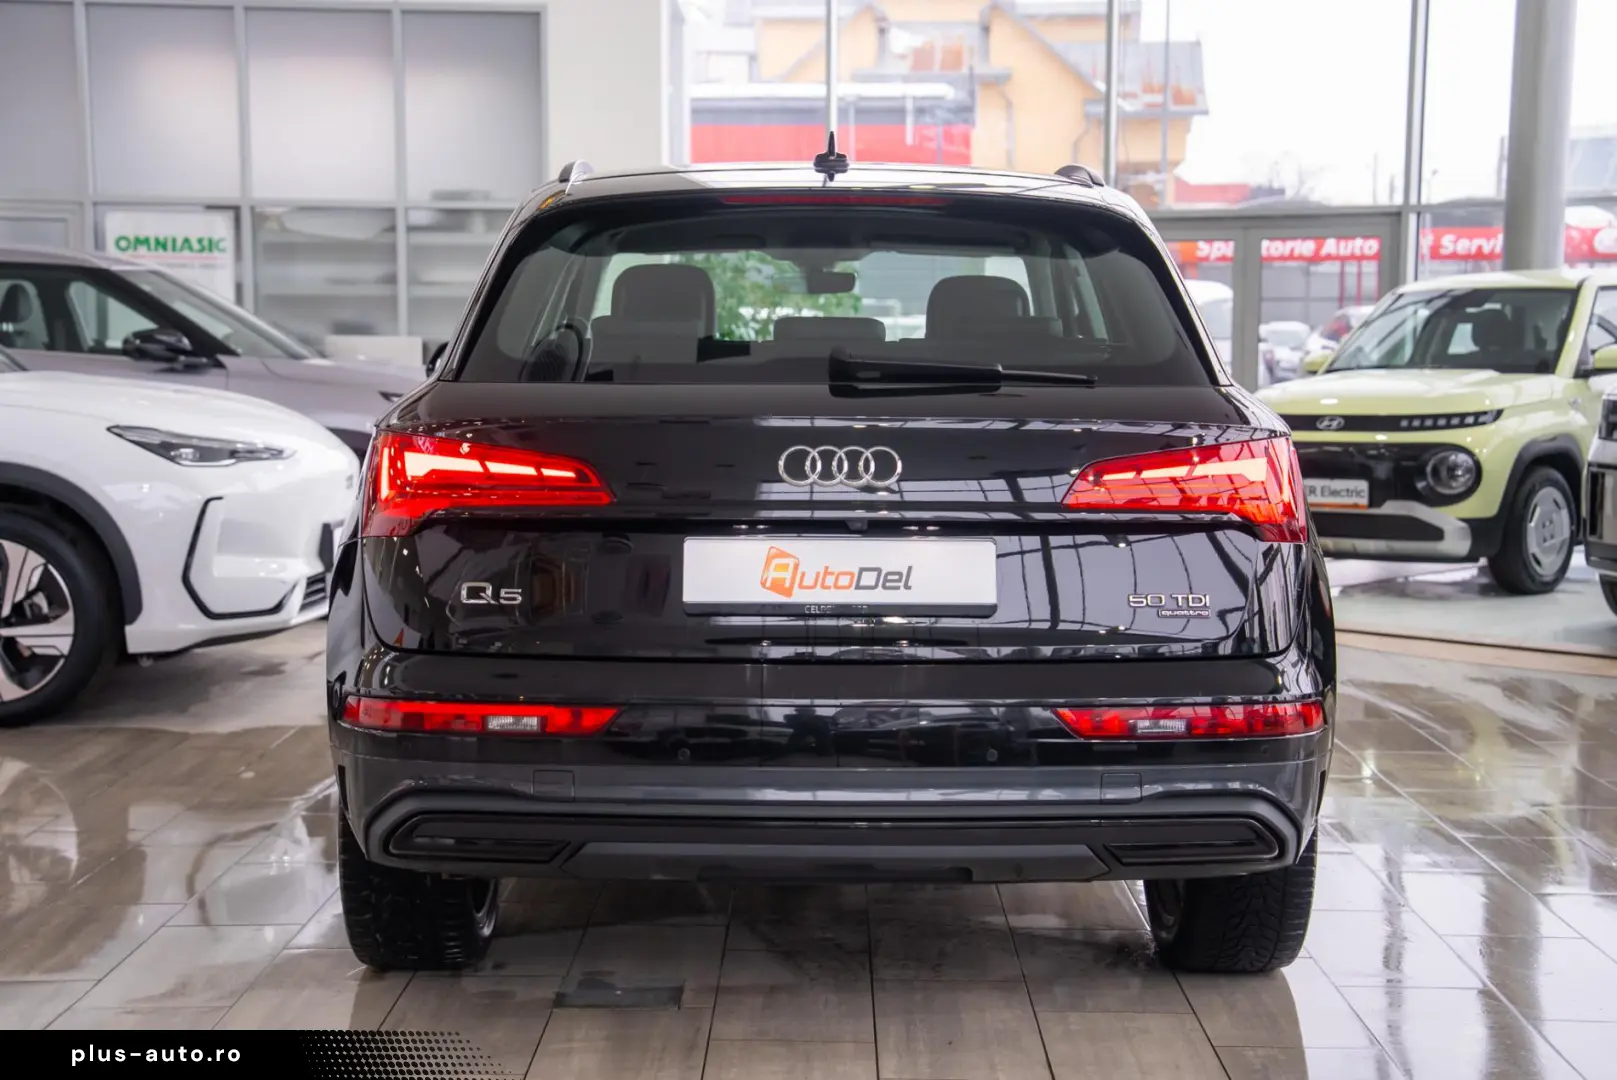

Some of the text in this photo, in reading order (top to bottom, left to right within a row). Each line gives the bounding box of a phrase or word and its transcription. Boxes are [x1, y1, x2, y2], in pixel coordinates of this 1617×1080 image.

[114, 235, 227, 253] OMNIASIC
[1320, 237, 1379, 257] Auto
[1439, 232, 1504, 256] Servi
[1320, 484, 1366, 499] Electric
[761, 556, 913, 593] AutoDel
[460, 581, 523, 605] Q5
[1128, 593, 1211, 608] 50 TDI
[1160, 609, 1210, 617] quattro
